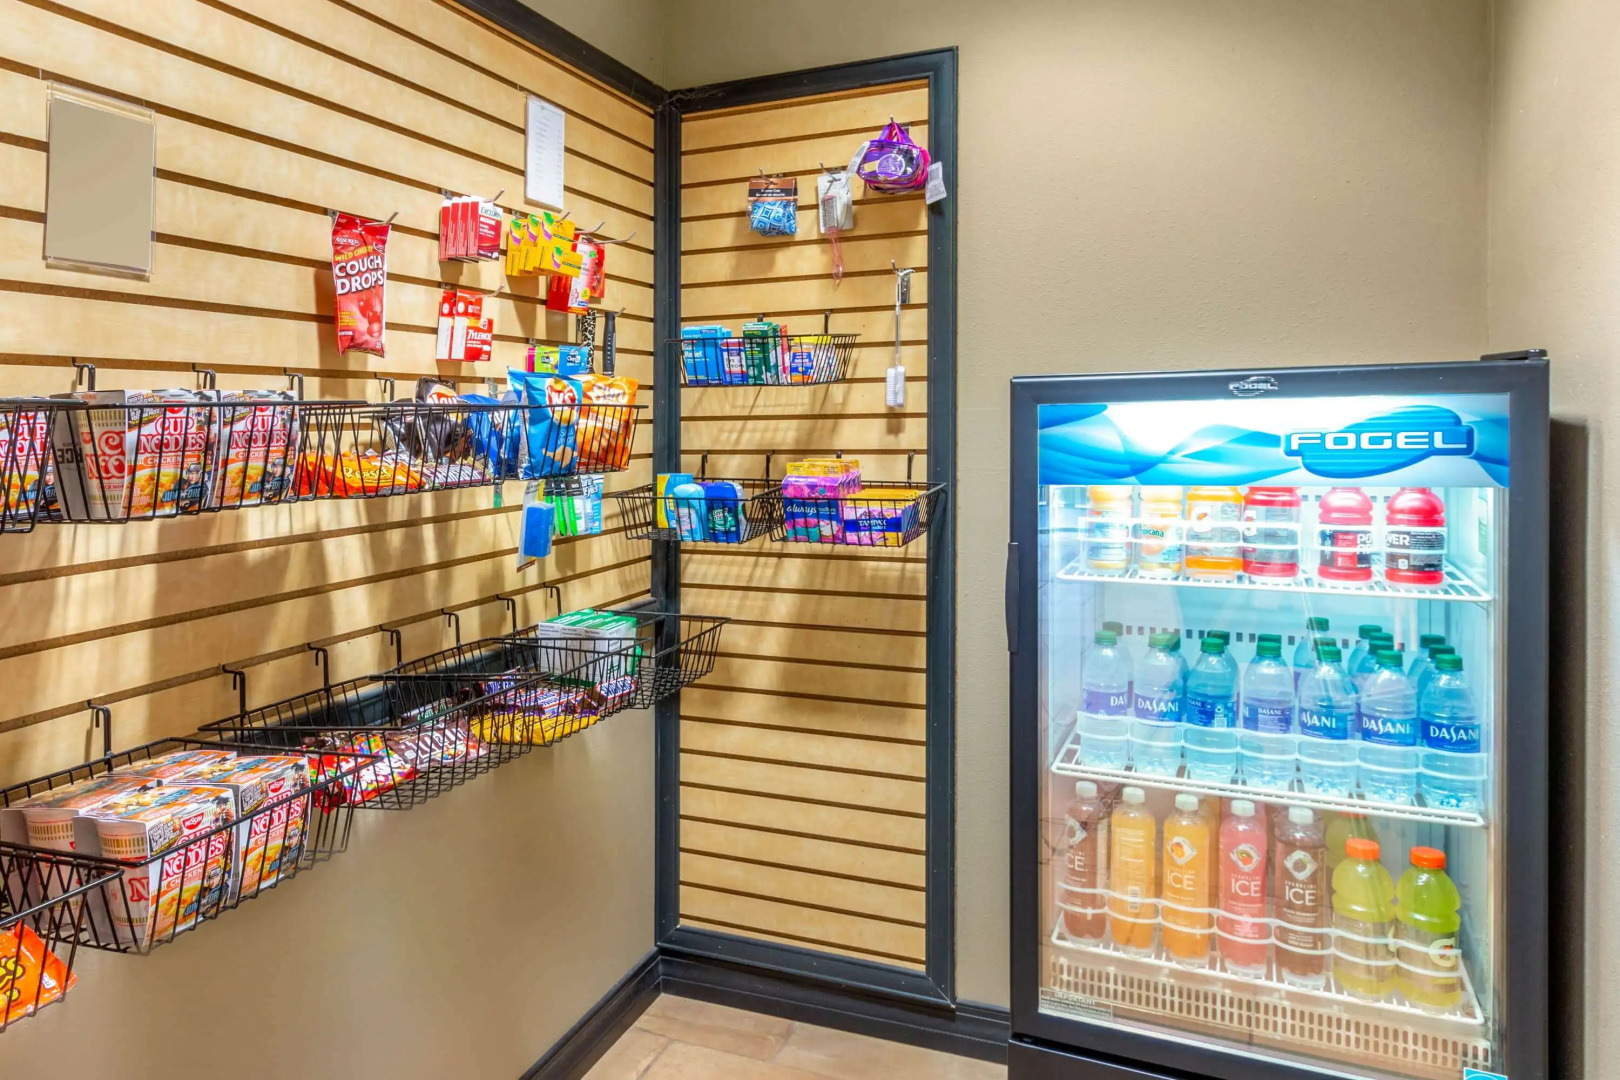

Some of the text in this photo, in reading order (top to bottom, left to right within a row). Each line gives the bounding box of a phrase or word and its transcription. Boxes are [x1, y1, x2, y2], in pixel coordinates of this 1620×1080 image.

[335, 255, 383, 277] COUGH
[336, 270, 385, 295] DROPS
[467, 329, 493, 341] TYLENOL
[1229, 381, 1279, 391] FOGEL
[1290, 431, 1468, 451] FOGEL
[786, 503, 817, 516] always
[859, 519, 887, 527] TAMPAX
[1137, 697, 1179, 714] DASANI
[1258, 707, 1282, 716] DASANI
[1362, 716, 1411, 735] DASANI
[1429, 725, 1479, 742] DASANI
[1167, 869, 1197, 891] ICE
[1231, 877, 1263, 897] ICE
[1285, 884, 1317, 906] ICE
